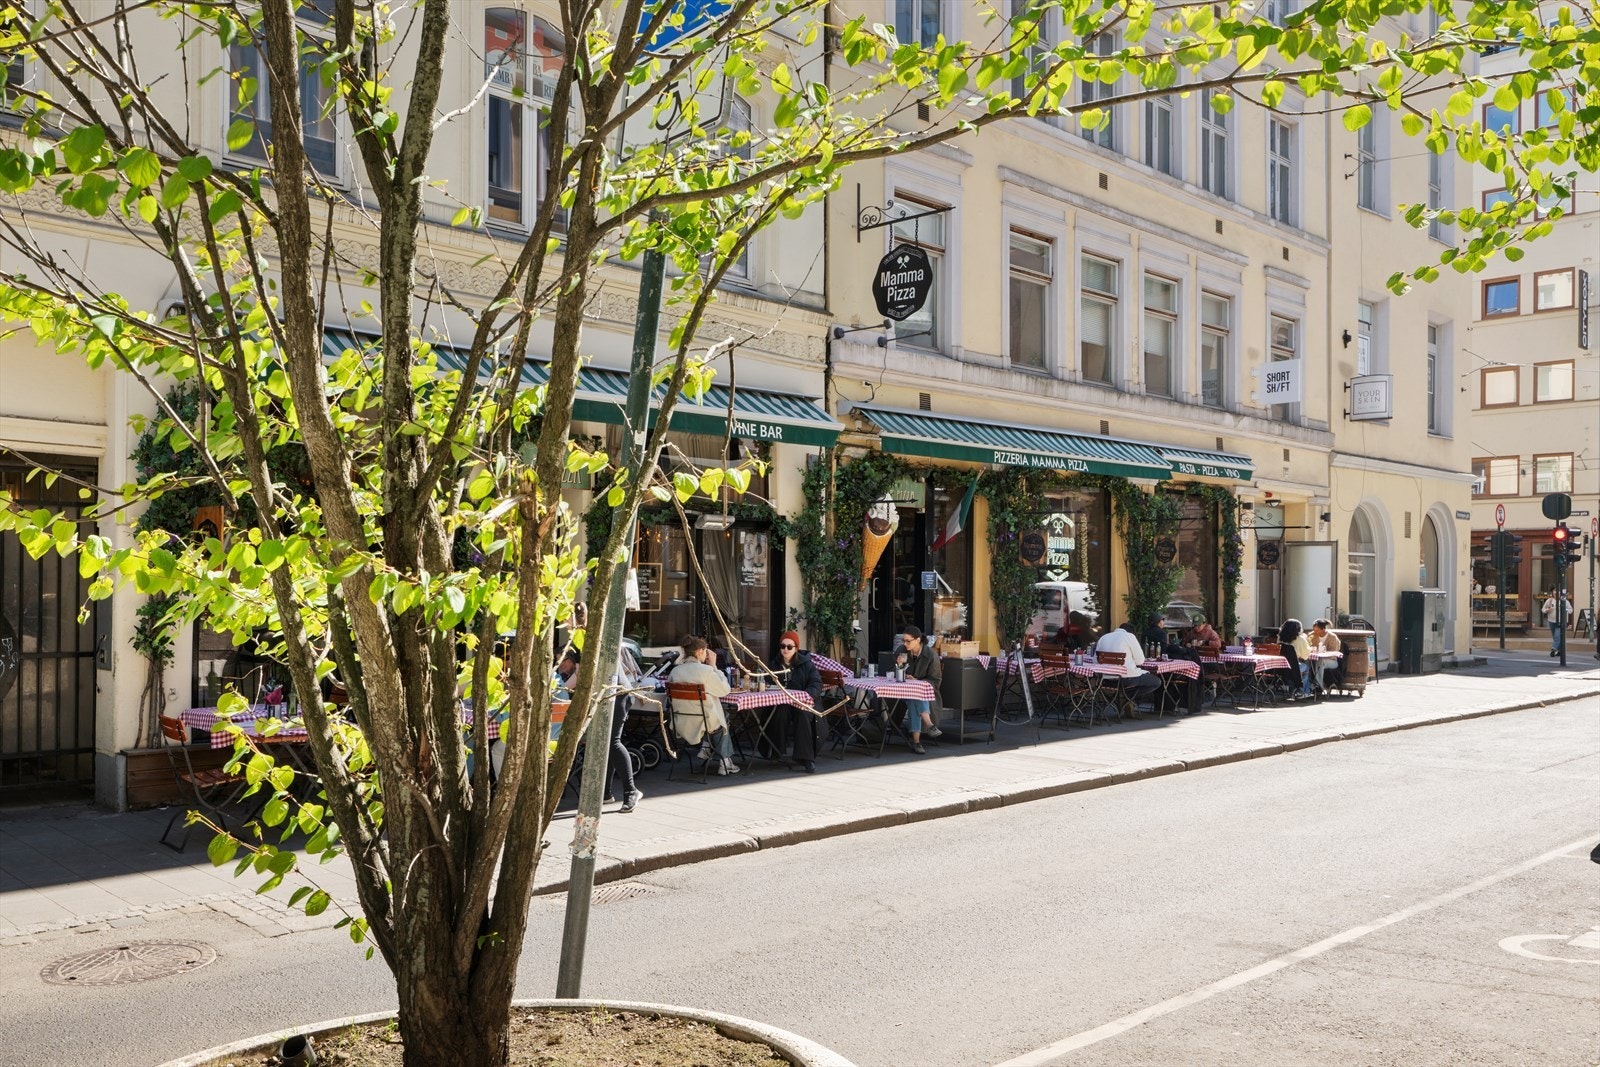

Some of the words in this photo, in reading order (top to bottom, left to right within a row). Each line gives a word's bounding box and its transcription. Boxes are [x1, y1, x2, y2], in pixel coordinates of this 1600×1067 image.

[488, 64, 515, 86] RMBA
[880, 268, 924, 288] Mamma
[887, 286, 916, 303] Pizza
[1266, 371, 1291, 383] SHORT
[1358, 389, 1381, 399] YOUR
[1358, 396, 1381, 405] SKIN
[724, 420, 757, 437] WINE
[759, 424, 783, 440] BAR
[993, 450, 1029, 466] PIZZERIA
[1031, 455, 1067, 470] MAMMA
[1067, 459, 1089, 472] PIZZA
[1178, 462, 1196, 474] PASTA
[1202, 465, 1220, 476] PIZZA
[1224, 468, 1240, 479] VINO
